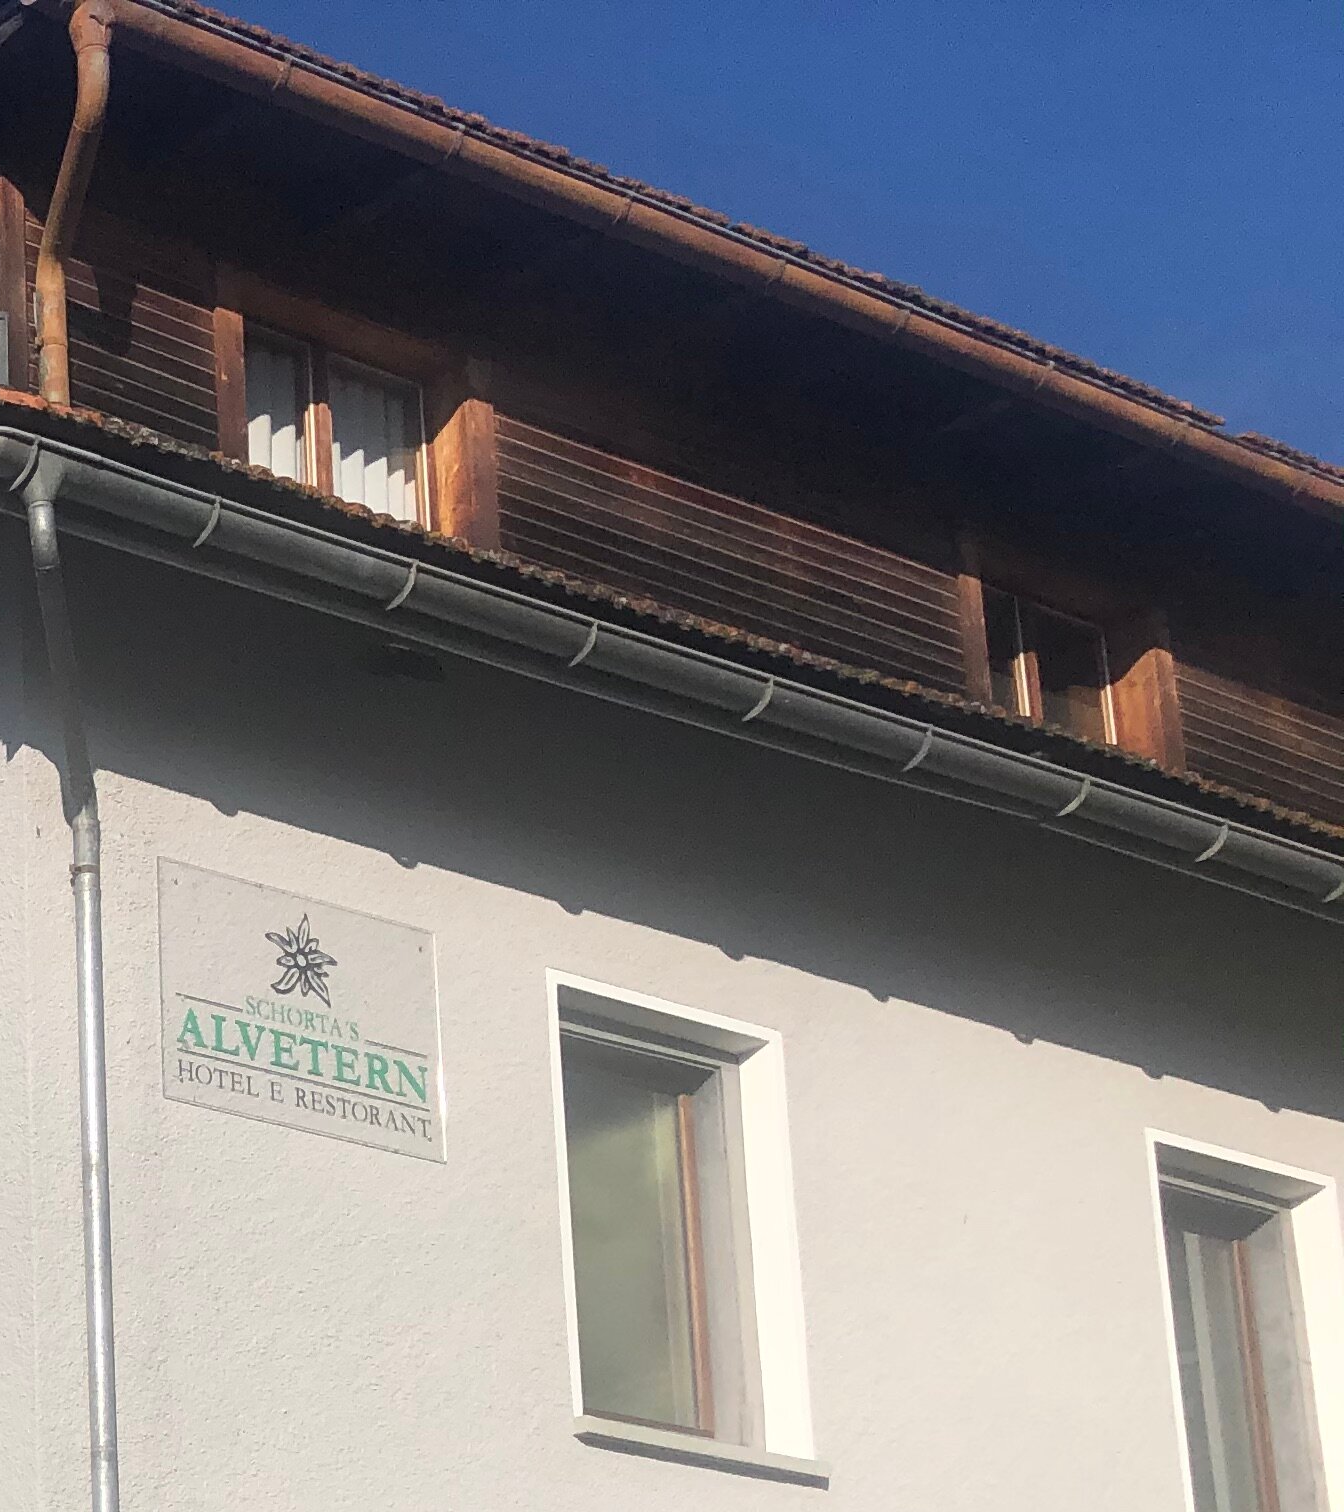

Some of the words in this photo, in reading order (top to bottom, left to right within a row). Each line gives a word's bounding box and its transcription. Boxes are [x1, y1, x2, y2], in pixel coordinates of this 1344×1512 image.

[176, 1008, 428, 1103] ALVETERN
[245, 996, 359, 1041] SCHORTA'S
[177, 1059, 260, 1098] HOTEL
[270, 1080, 285, 1103] E
[294, 1086, 433, 1138] RESTORANT
